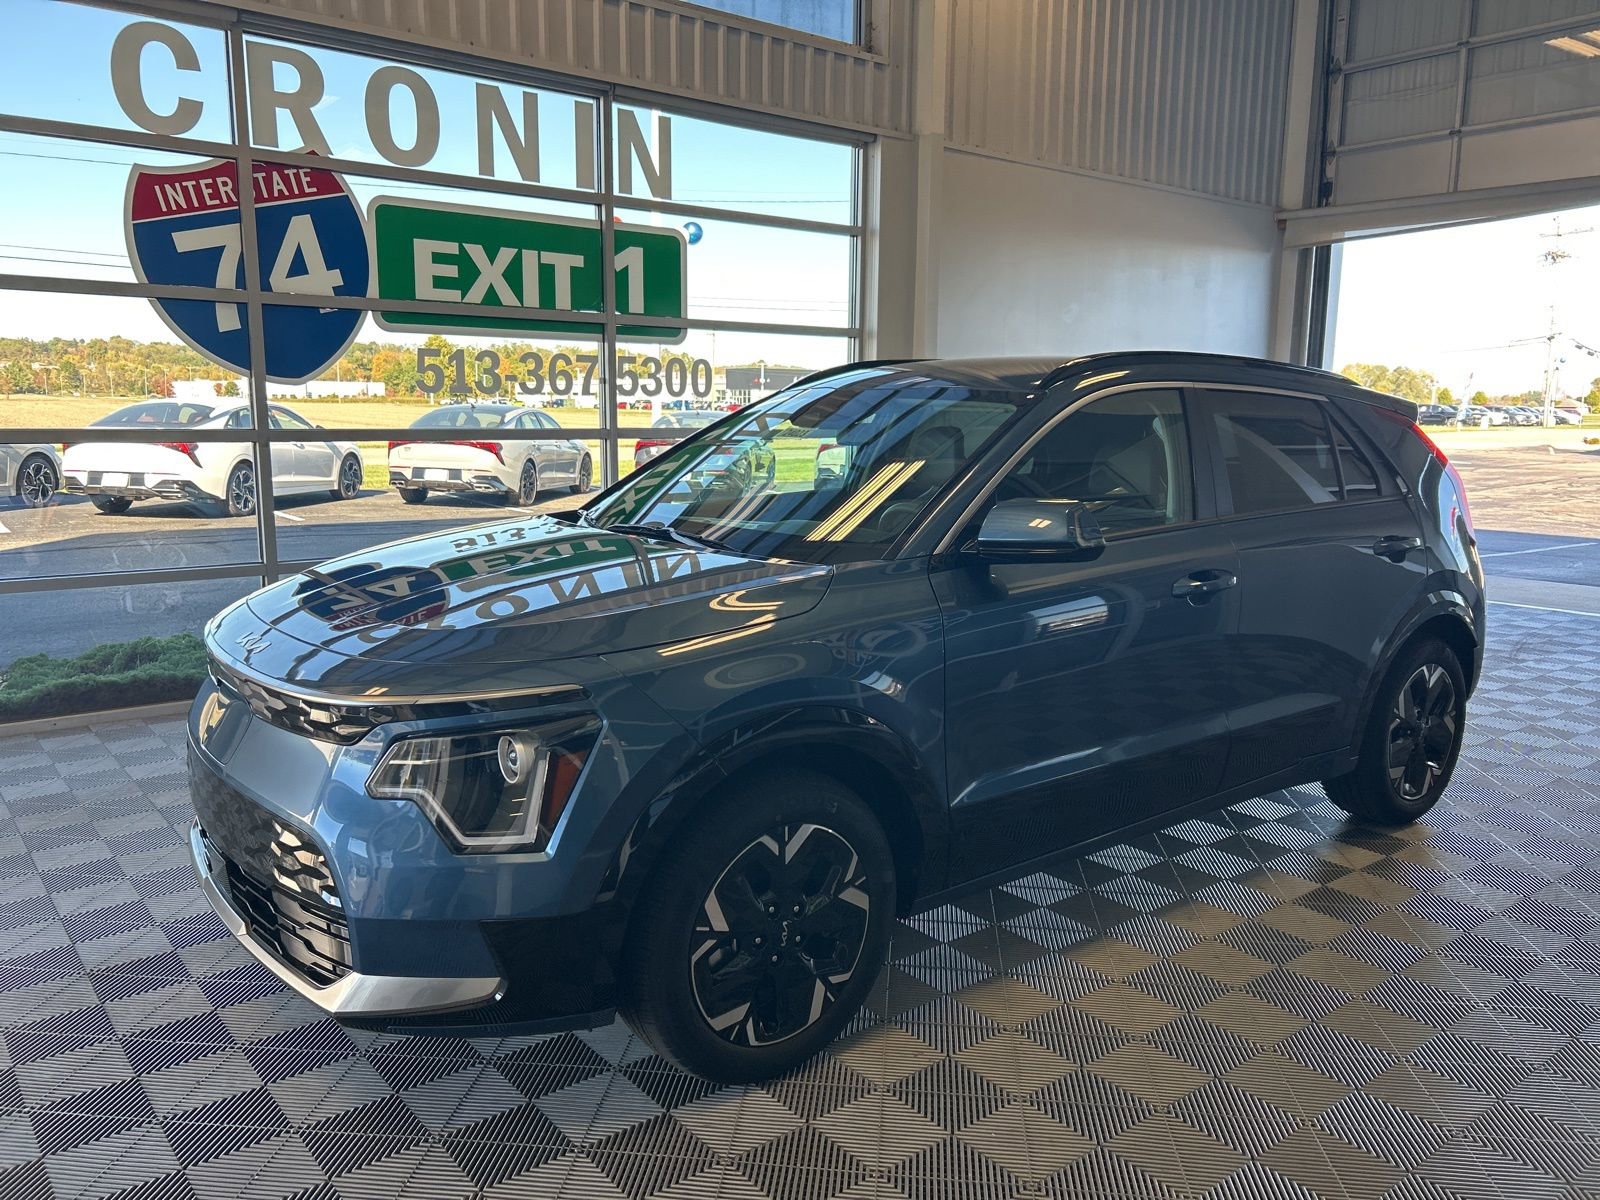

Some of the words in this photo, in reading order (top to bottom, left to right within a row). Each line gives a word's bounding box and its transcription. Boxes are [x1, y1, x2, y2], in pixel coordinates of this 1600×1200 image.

[111, 21, 673, 200] CRONIN
[154, 168, 318, 212] INTERTATE
[171, 213, 344, 333] 74
[413, 238, 585, 310] EXIT
[614, 246, 645, 314] 1
